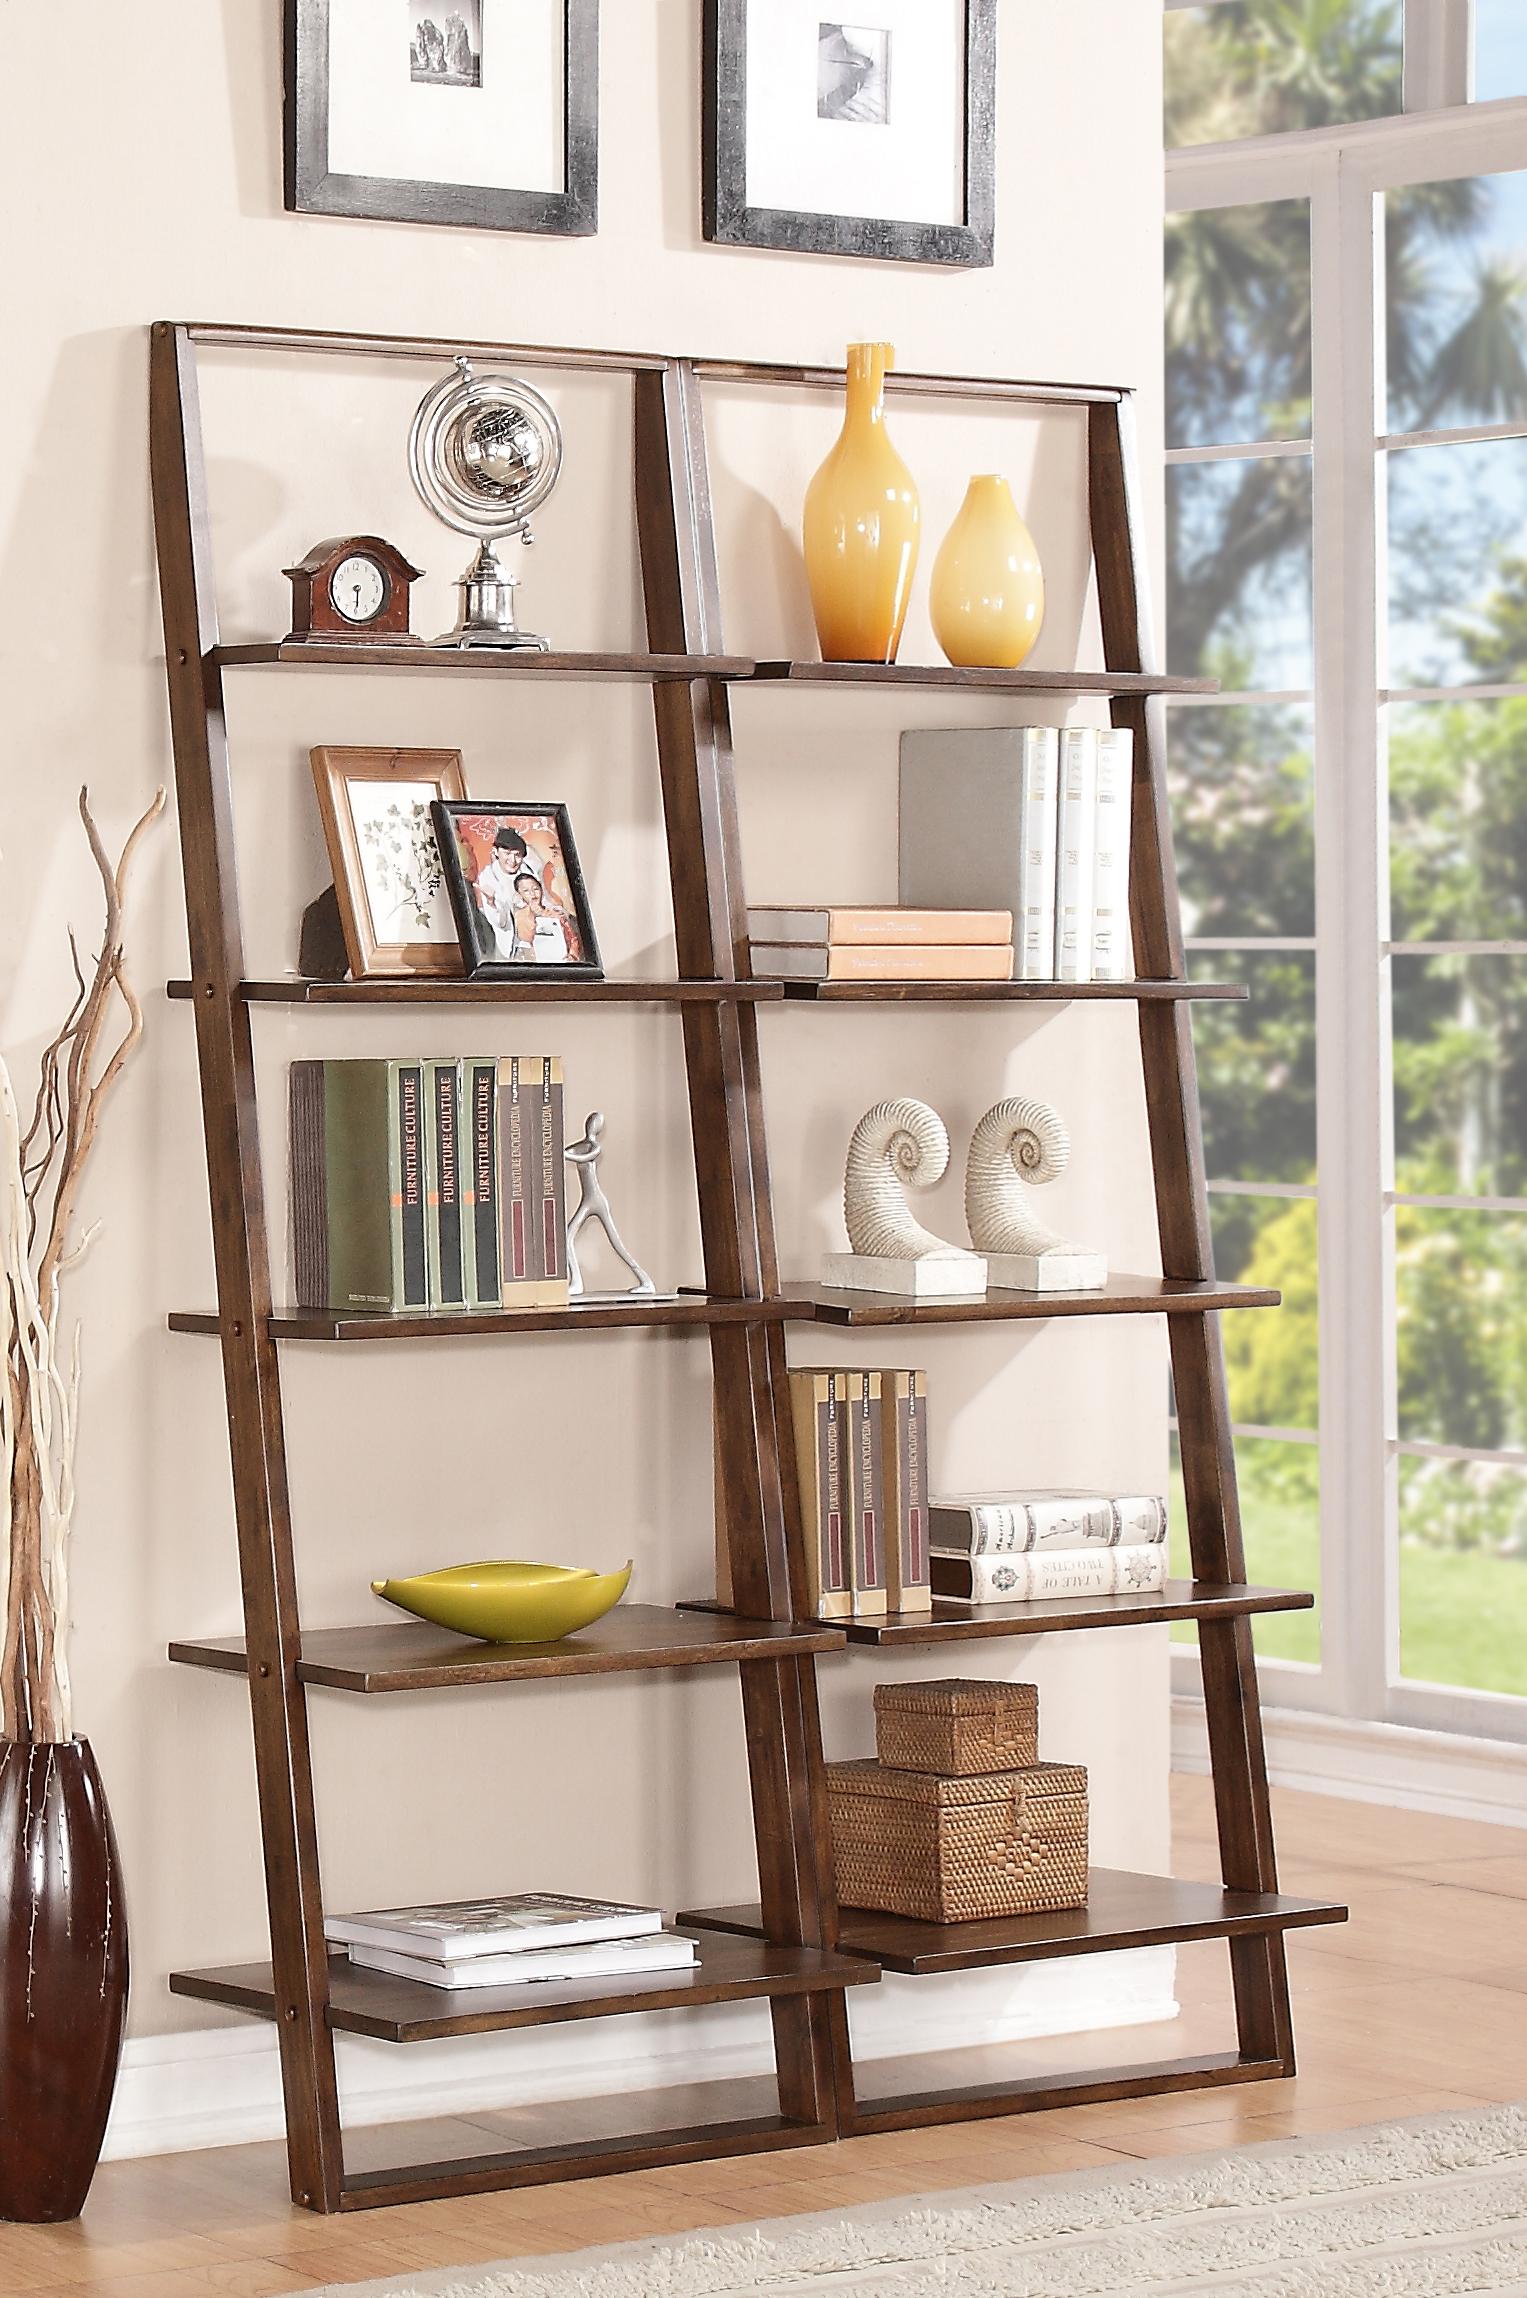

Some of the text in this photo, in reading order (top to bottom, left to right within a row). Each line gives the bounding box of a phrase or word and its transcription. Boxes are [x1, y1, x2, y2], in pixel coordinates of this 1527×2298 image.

[352, 562, 360, 571] 12
[404, 1078, 418, 1204] FURNITURE CULTURE
[440, 1076, 454, 1203] FURNITURE CULTURE
[478, 1076, 491, 1202] FURNITURE CULTURE
[511, 1158, 521, 1197] FURNITURE
[542, 1157, 554, 1196] FURNITURE
[828, 1472, 839, 1510] FURNITURE
[862, 1471, 873, 1508] FURNITURE
[908, 1468, 919, 1505] FURNITURE
